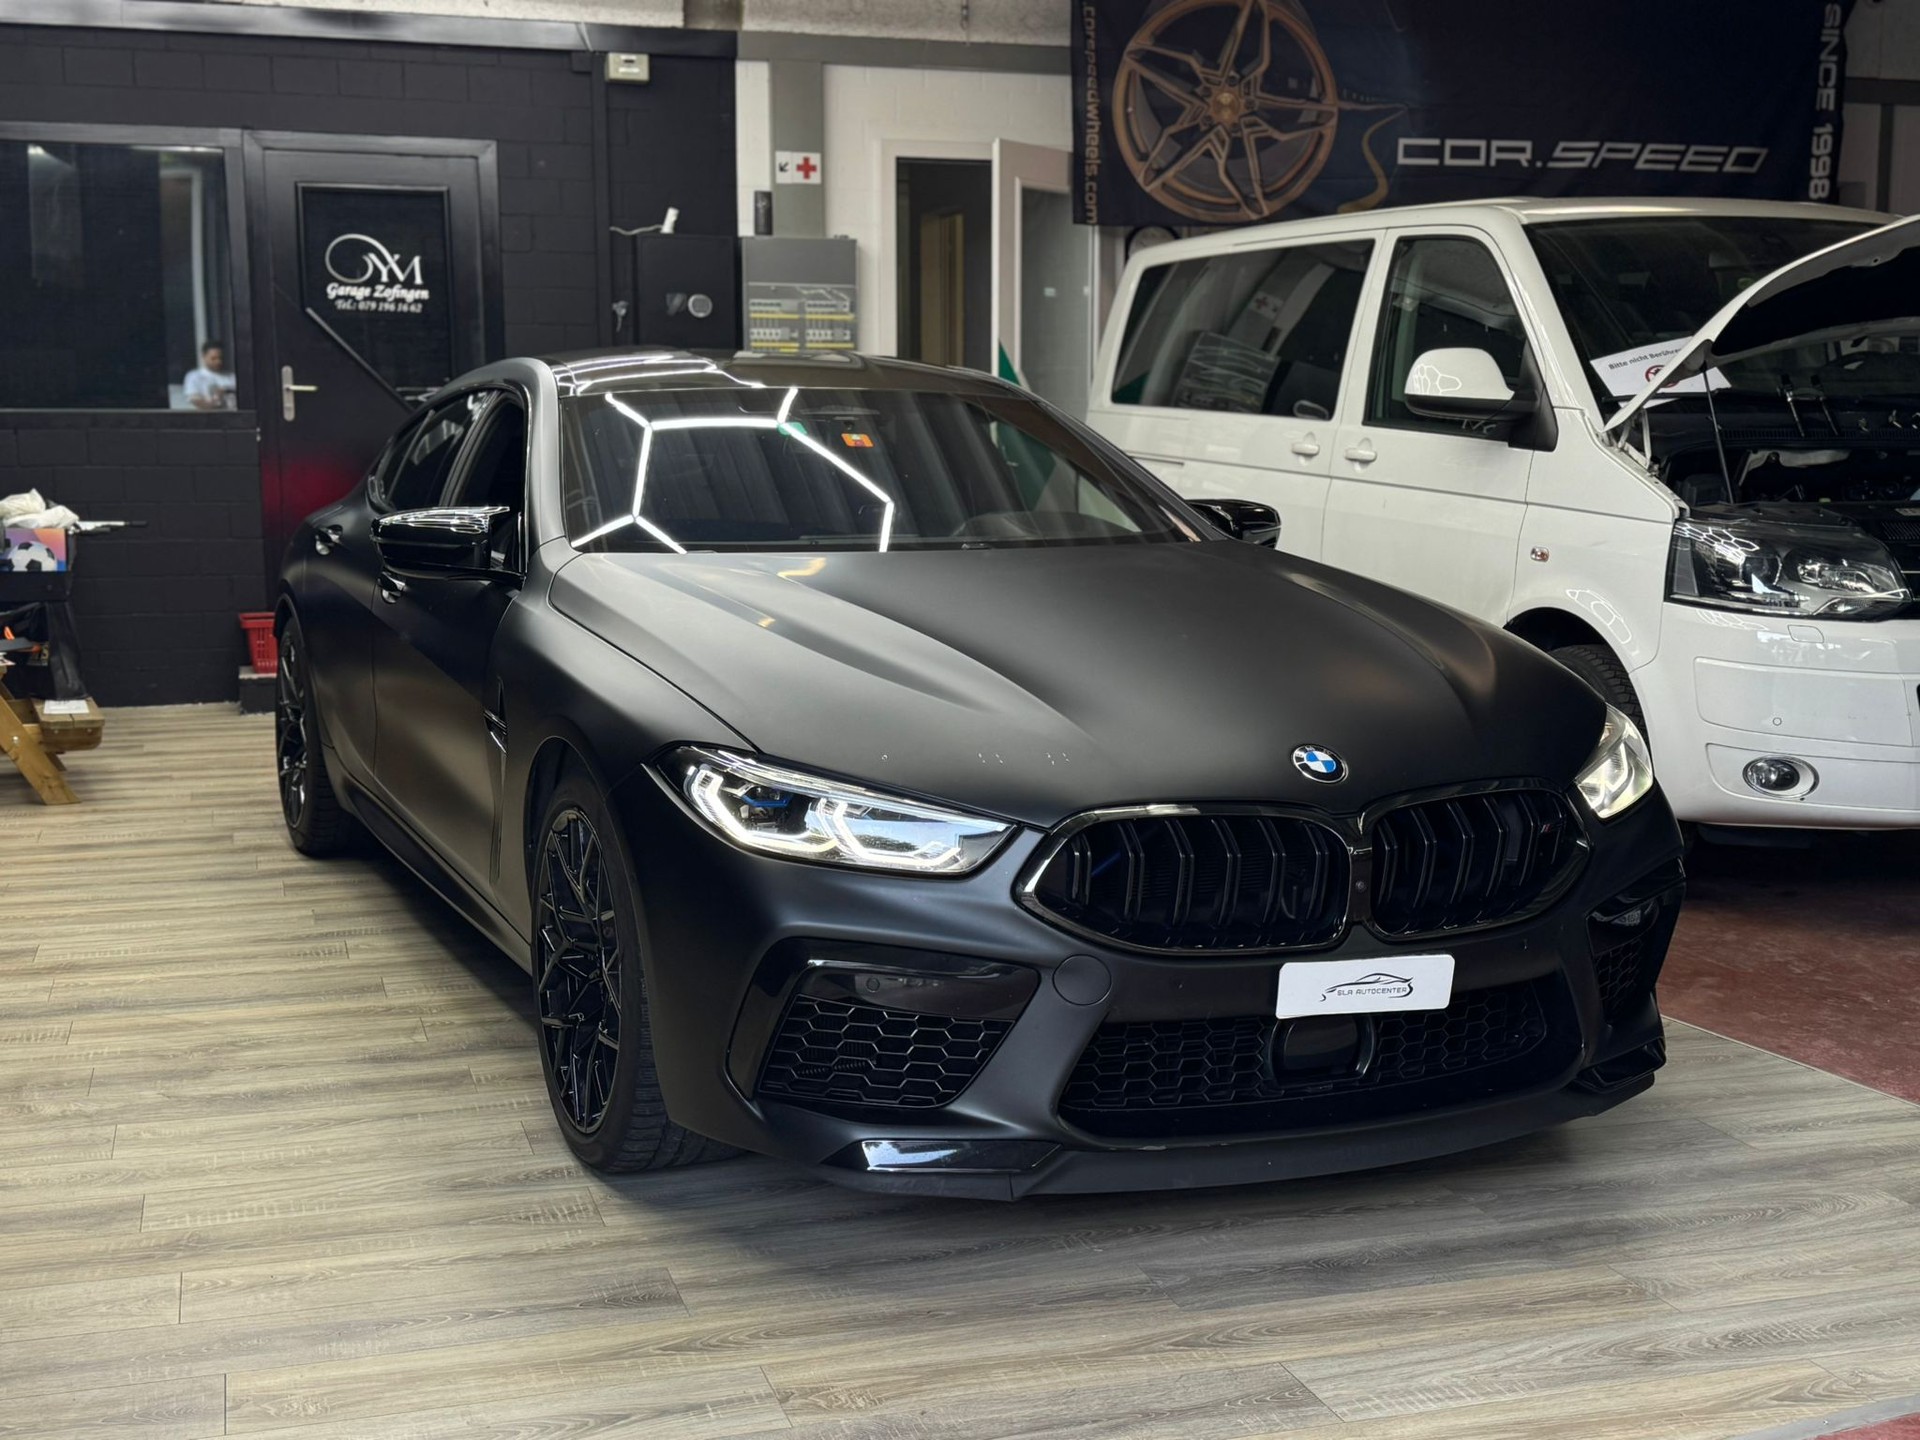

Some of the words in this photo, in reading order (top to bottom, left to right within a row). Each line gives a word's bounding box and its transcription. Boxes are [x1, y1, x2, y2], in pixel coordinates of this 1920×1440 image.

[1816, 3, 1841, 111] SINCE
[1397, 137, 1768, 173] COR.SPEED
[1808, 123, 1834, 199] 1998
[326, 282, 371, 301] Garage
[373, 284, 429, 303] Zofingen
[1608, 361, 1628, 370] Bitte
[1629, 354, 1649, 364] nicht
[1356, 987, 1407, 995] AUTOCENTER
